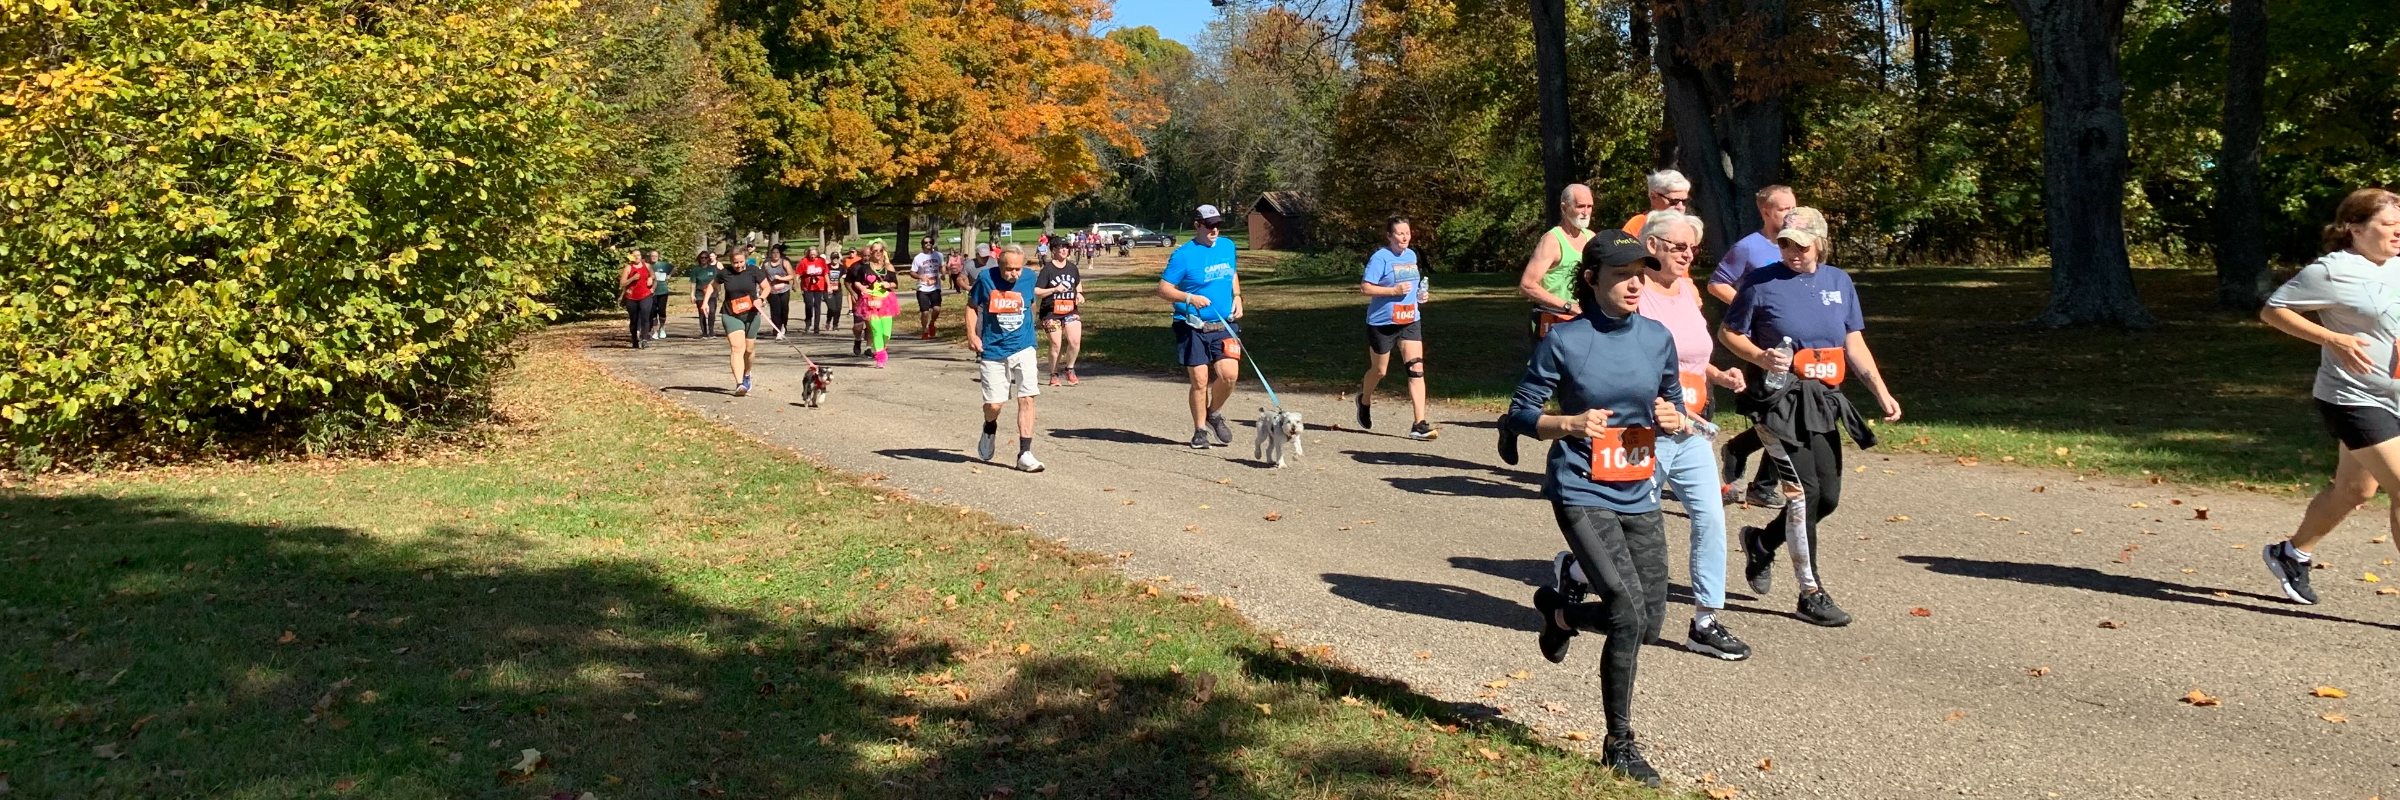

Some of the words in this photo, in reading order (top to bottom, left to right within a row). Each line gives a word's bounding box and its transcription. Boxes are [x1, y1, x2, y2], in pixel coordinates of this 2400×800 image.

[993, 297, 1018, 309] 1026
[1395, 310, 1415, 320] 1042
[1804, 362, 1837, 378] 599
[1600, 446, 1651, 469] 1043
